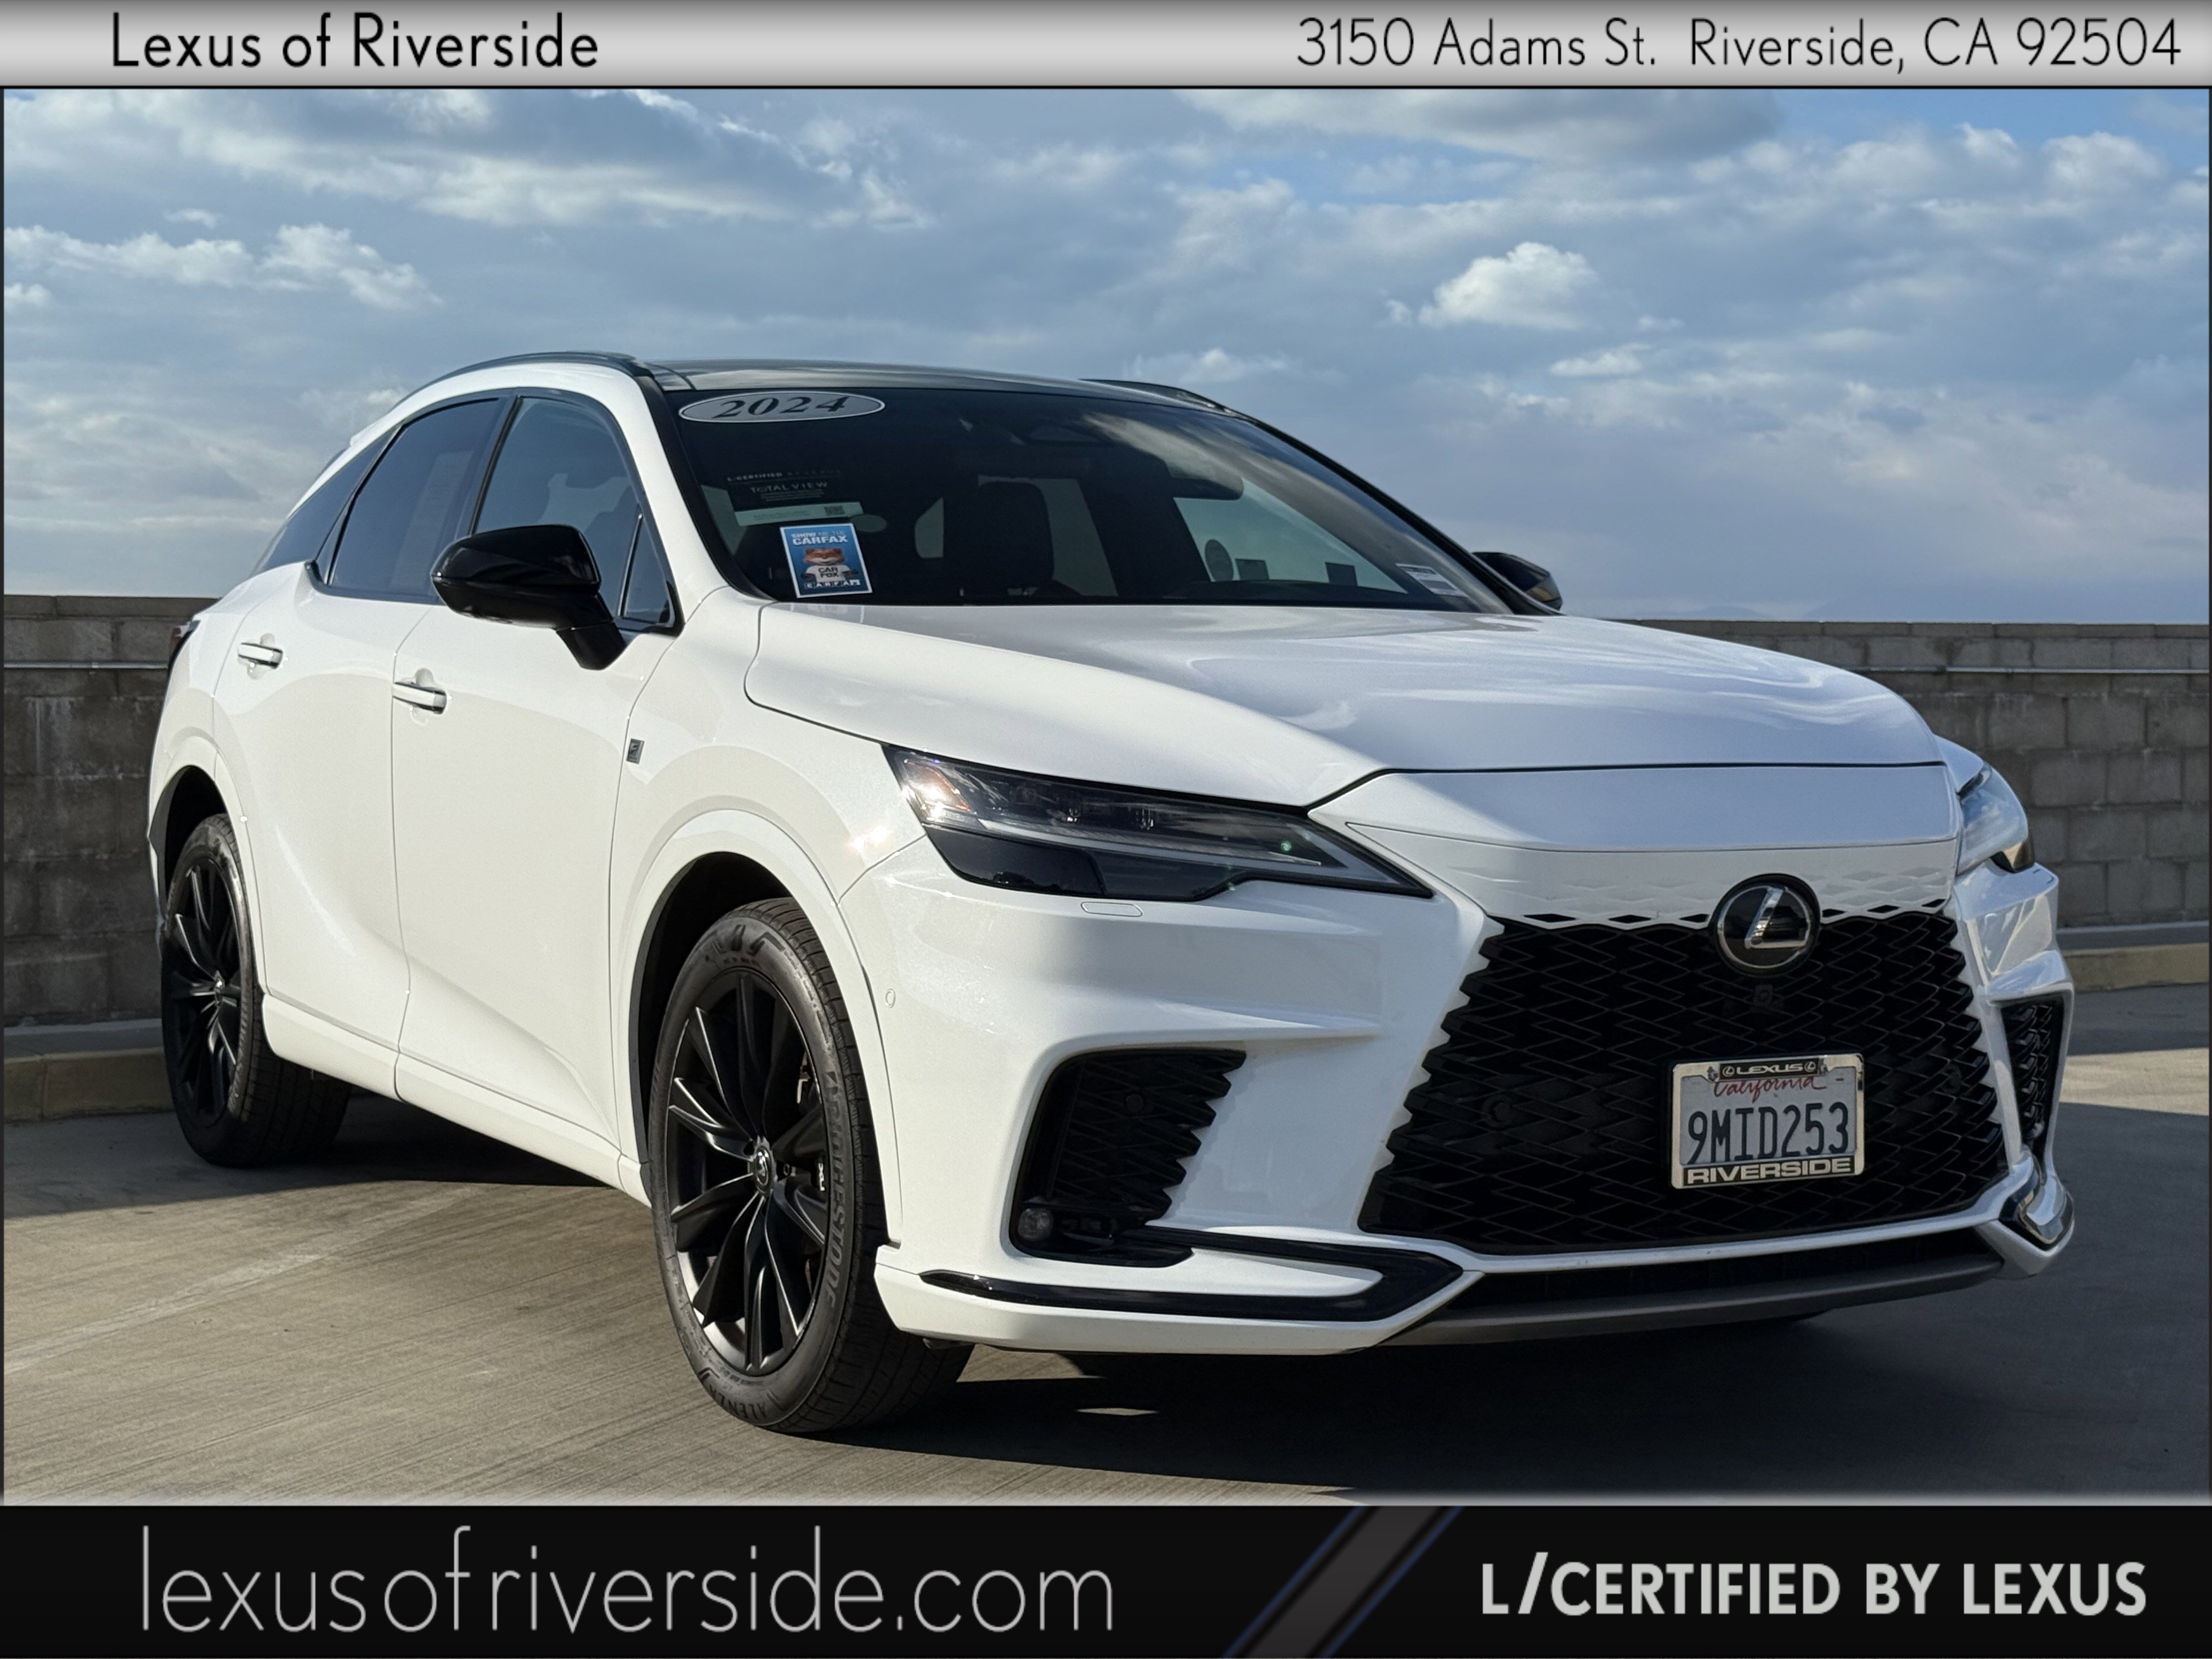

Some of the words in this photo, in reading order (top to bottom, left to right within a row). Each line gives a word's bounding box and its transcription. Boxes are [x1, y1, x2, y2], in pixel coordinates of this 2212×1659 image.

[712, 396, 850, 419] 2024
[792, 535, 849, 546] CARFAX
[1736, 1062, 1804, 1074] LEXUS
[1713, 1075, 1827, 1103] California
[1687, 1102, 1849, 1165] 9MID253
[1687, 1157, 1852, 1185] RIVERSIDE
